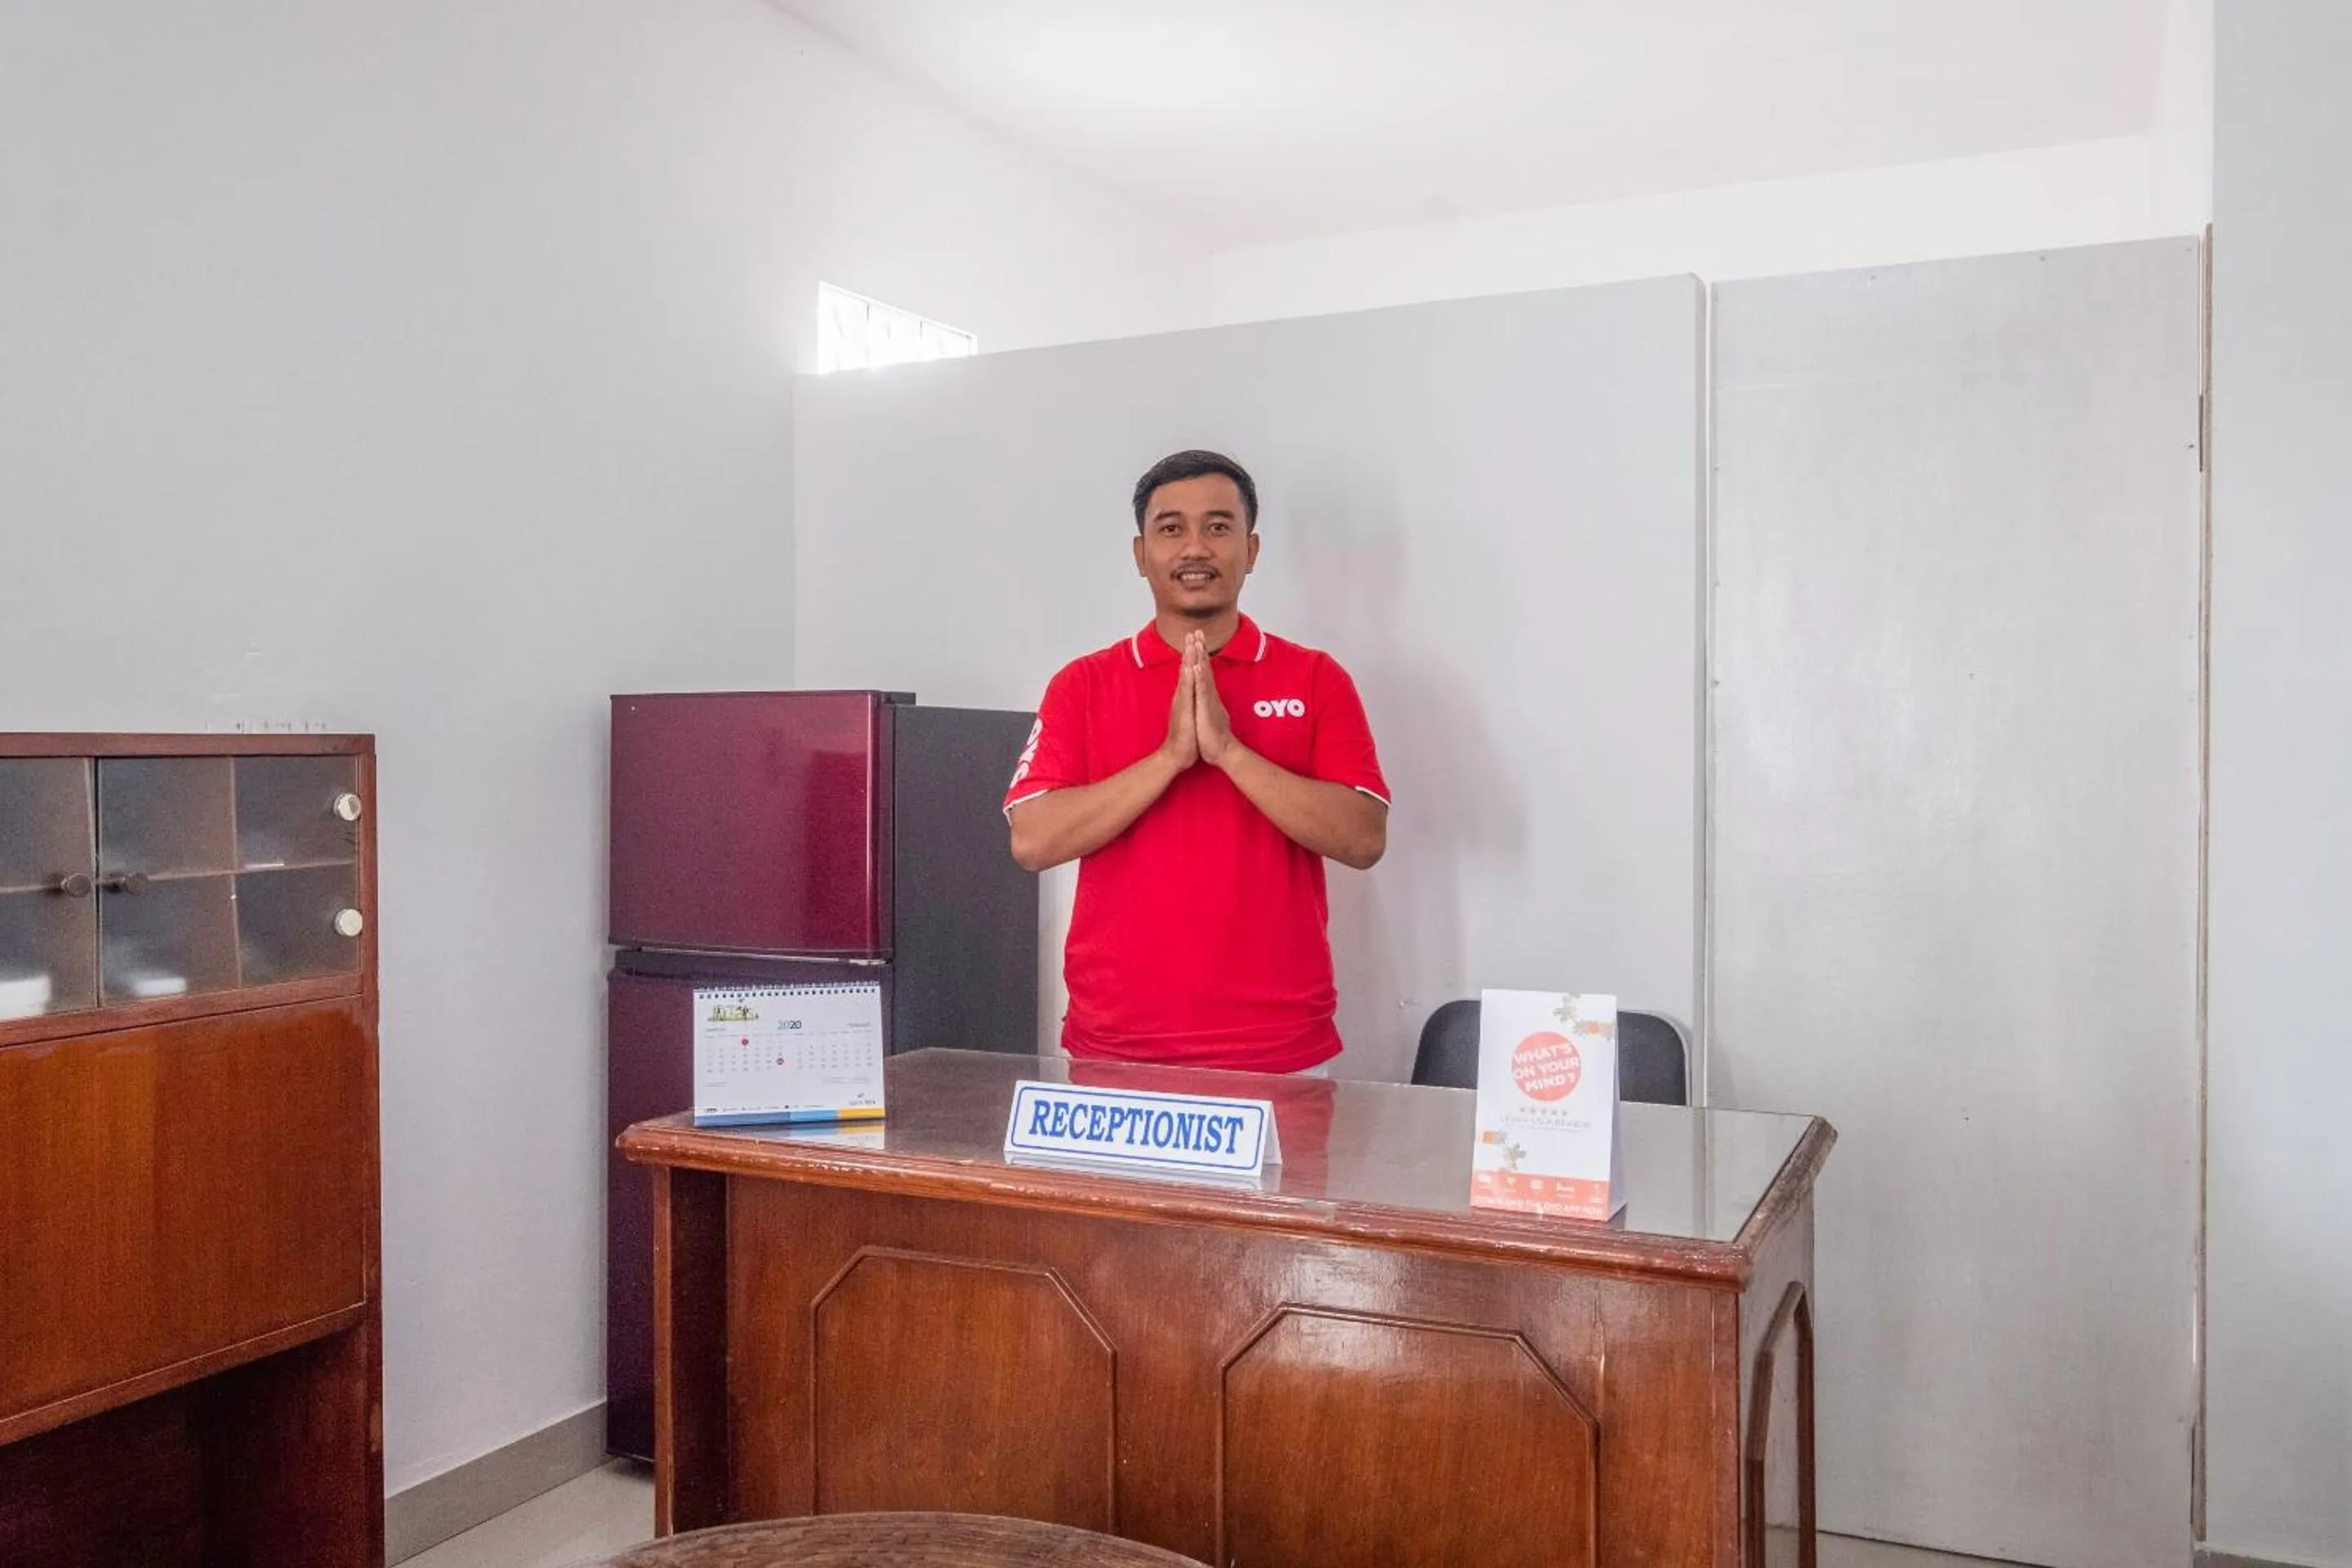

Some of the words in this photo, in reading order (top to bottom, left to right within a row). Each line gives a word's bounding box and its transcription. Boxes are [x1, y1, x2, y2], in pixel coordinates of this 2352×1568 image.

[1254, 699, 1305, 718] OYO
[777, 1020, 802, 1030] 2020
[1514, 1043, 1573, 1065] WHAT'S
[1512, 1065, 1535, 1079] ON
[1538, 1057, 1580, 1075] YOUR
[1029, 1100, 1244, 1154] RECEPTIONIST
